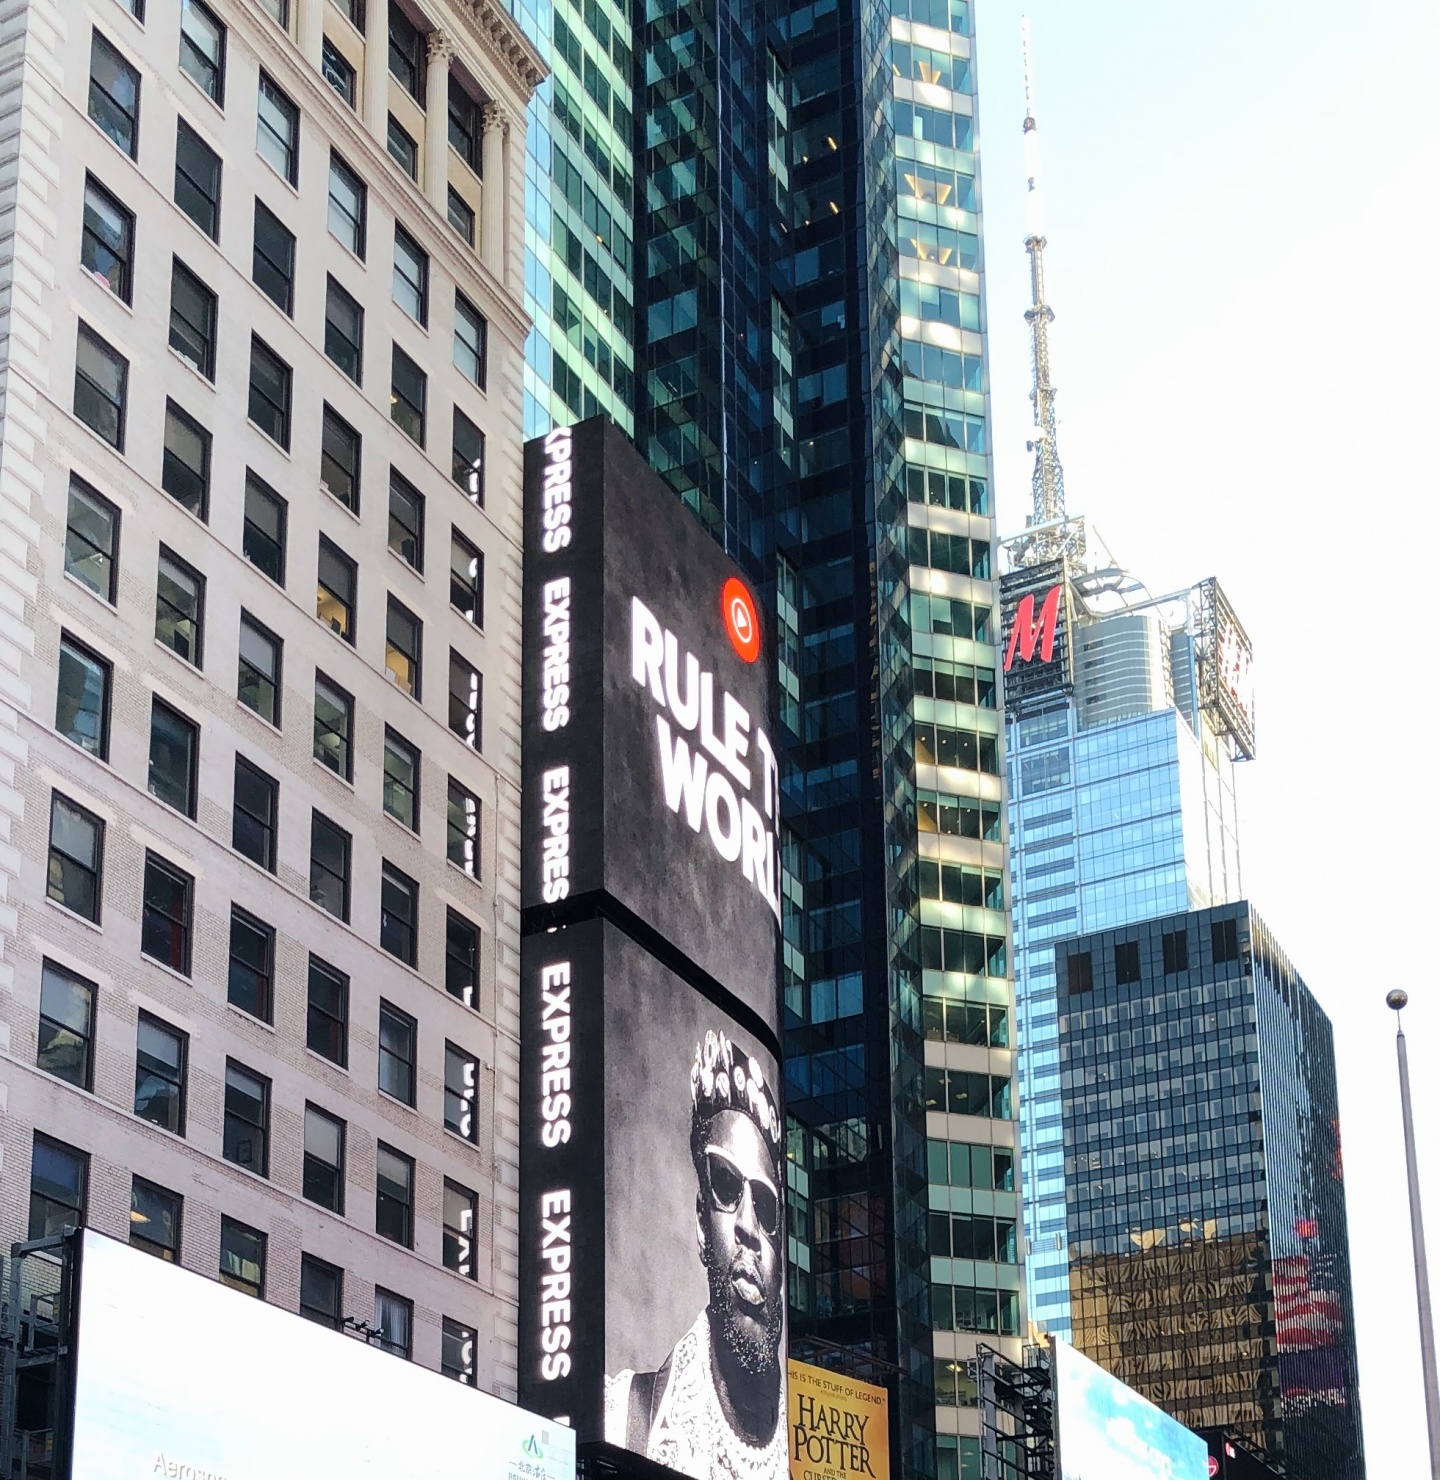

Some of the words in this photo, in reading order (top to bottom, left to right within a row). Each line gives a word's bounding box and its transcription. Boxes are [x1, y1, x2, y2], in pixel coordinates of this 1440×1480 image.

[542, 576, 572, 732] EXPRESS
[631, 596, 750, 785] RULE
[758, 726, 778, 838] T
[541, 765, 572, 904] EXPRES
[655, 714, 781, 925] WORL
[541, 960, 571, 1149] EXPRESS
[541, 1189, 571, 1382] EXPRESS
[793, 1424, 876, 1479] POTTER
[797, 1393, 869, 1446] HARRY
[808, 1375, 821, 1388] THE
[823, 1380, 843, 1394] STUFF
[845, 1387, 854, 1397] OF
[824, 1467, 835, 1477] AND
[836, 1470, 846, 1480] THE
